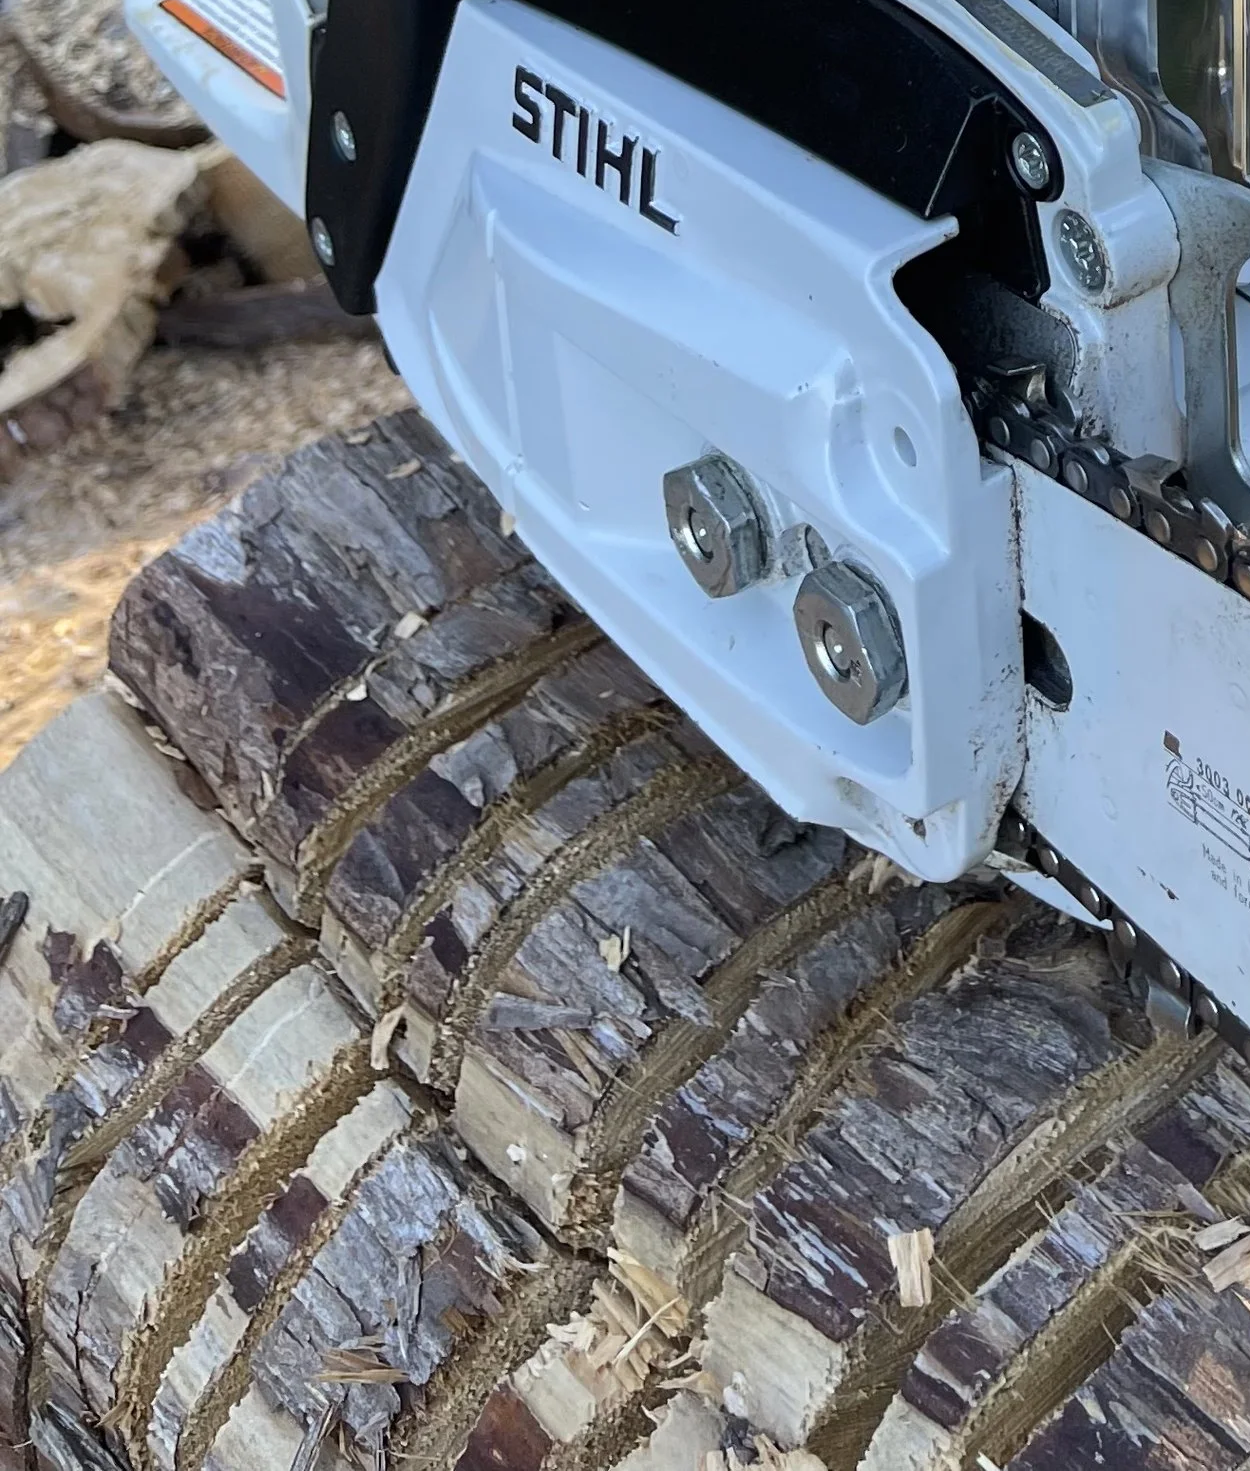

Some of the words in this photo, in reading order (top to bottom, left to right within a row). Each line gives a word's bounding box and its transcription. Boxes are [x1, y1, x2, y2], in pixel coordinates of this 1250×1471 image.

[511, 64, 682, 237] STIHL
[1196, 755, 1229, 798] 3003
[1202, 842, 1226, 874] Made
[1232, 870, 1242, 887] in
[1211, 869, 1227, 890] and
